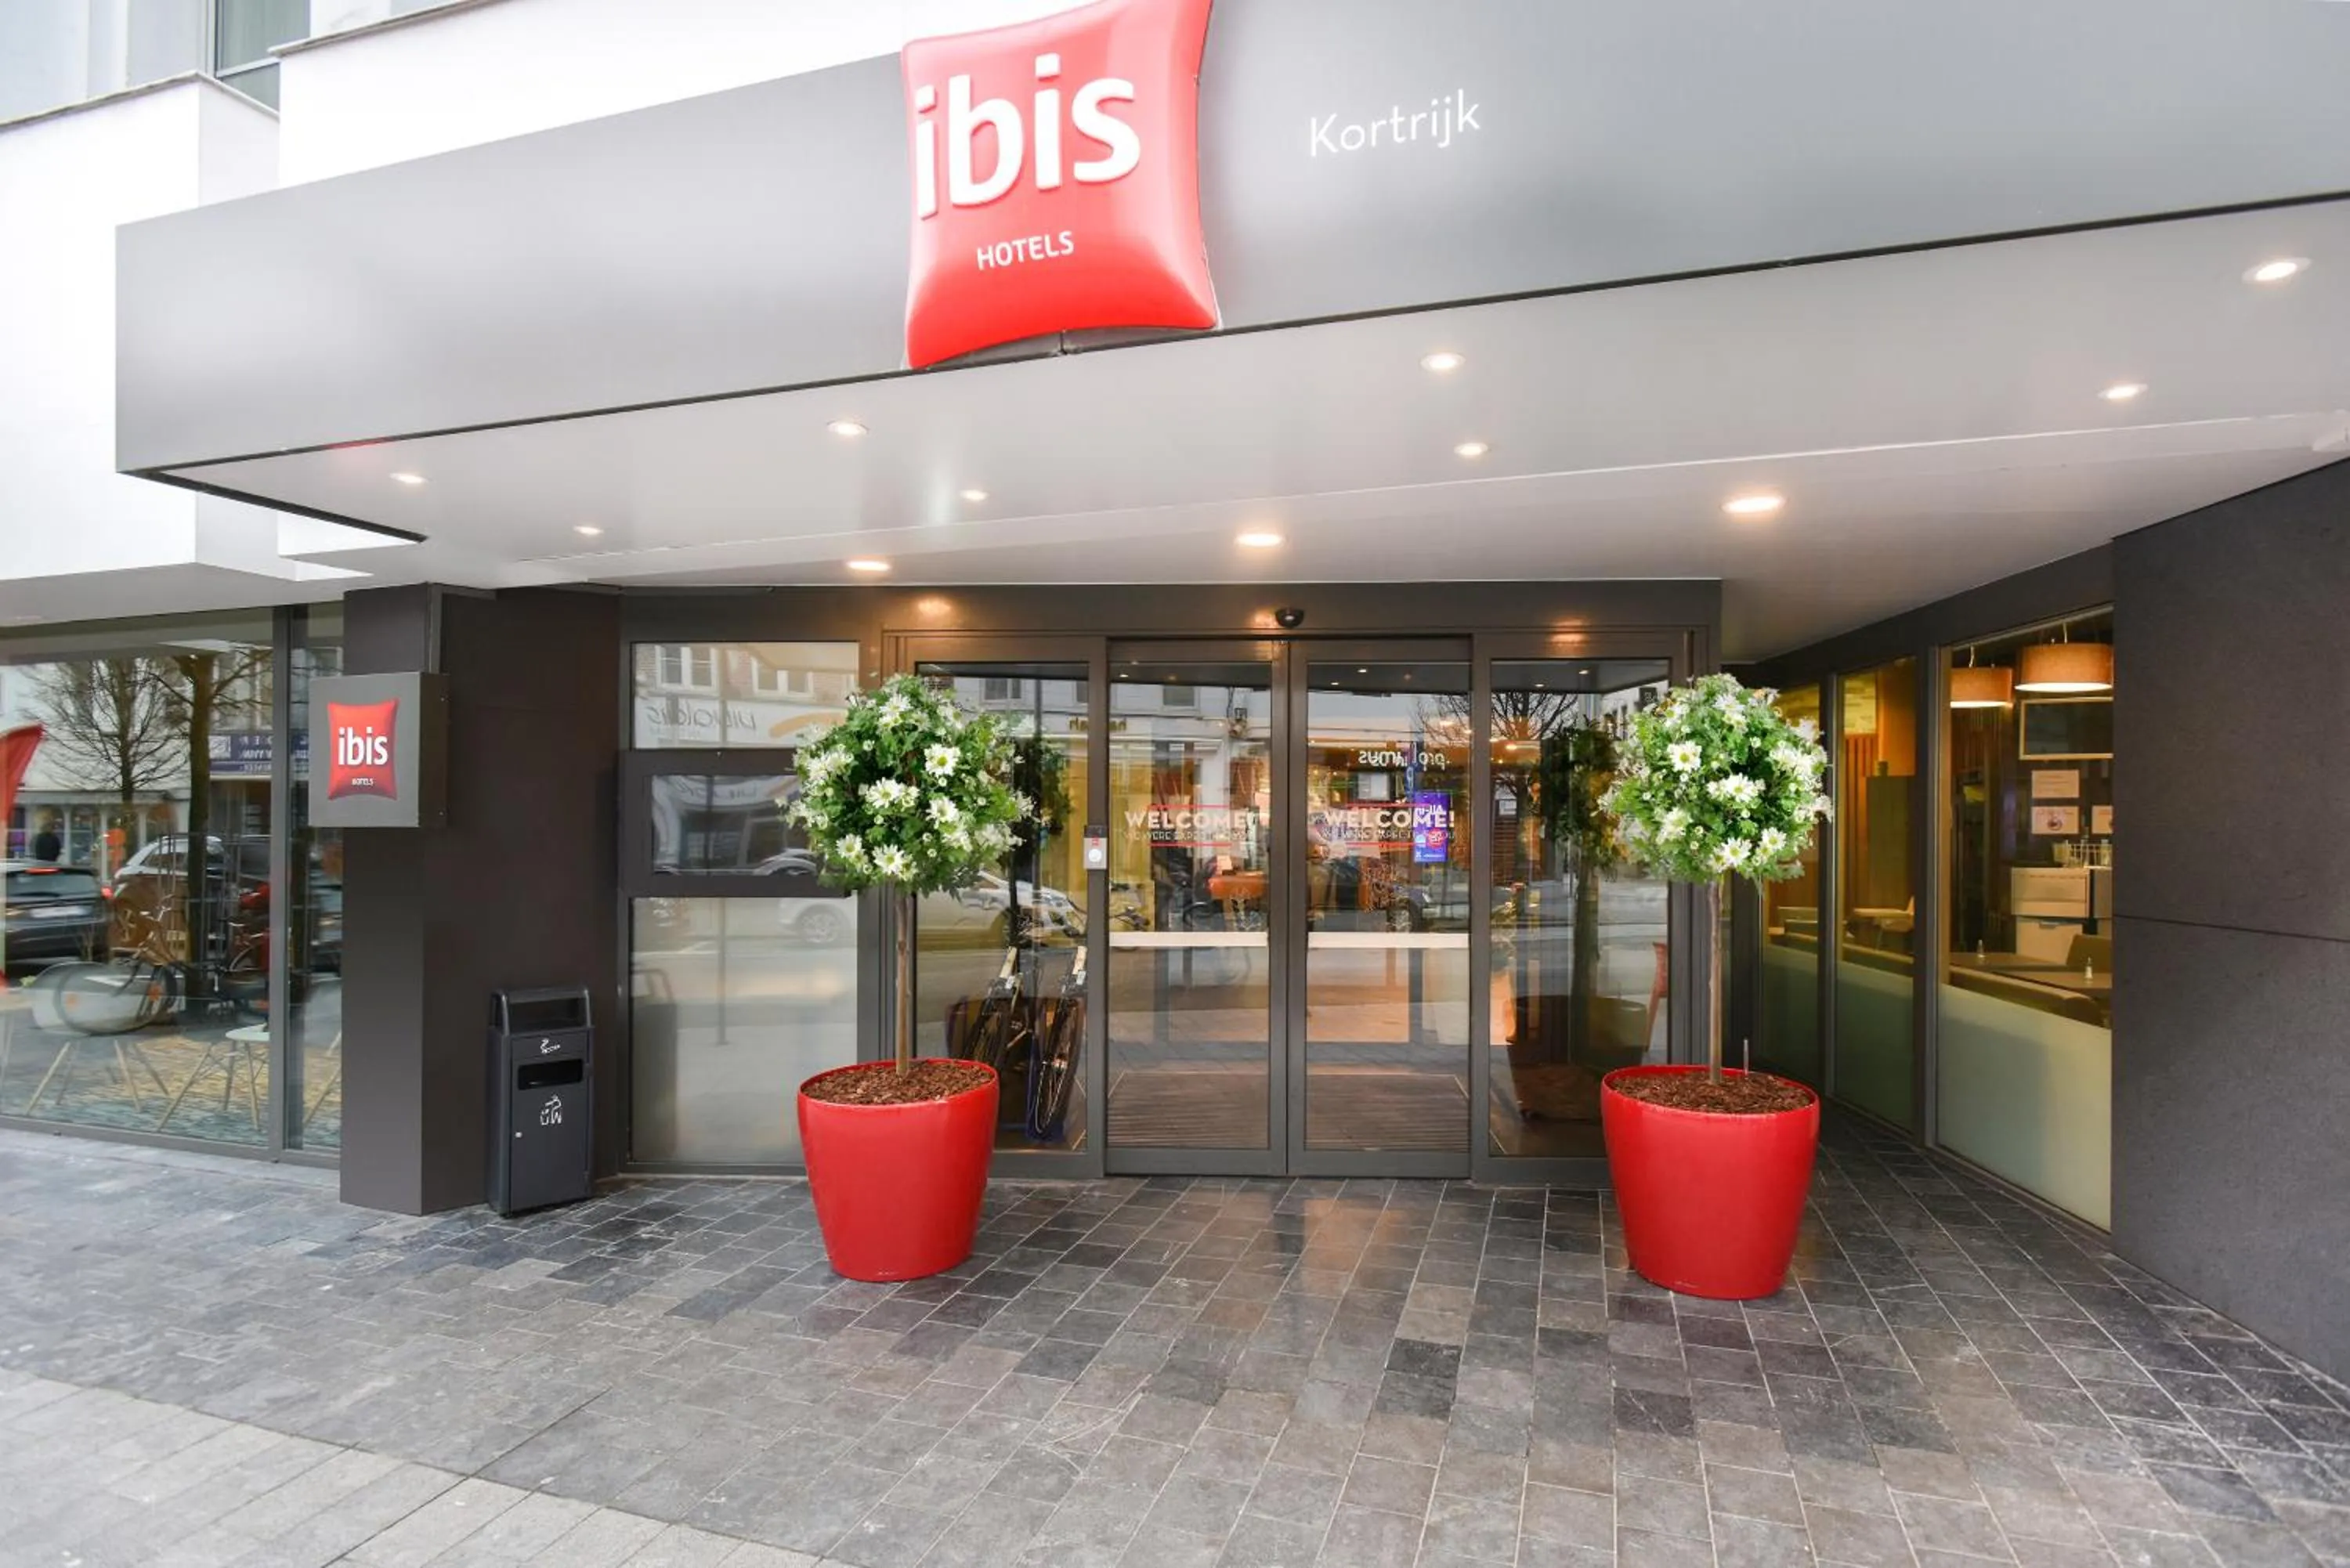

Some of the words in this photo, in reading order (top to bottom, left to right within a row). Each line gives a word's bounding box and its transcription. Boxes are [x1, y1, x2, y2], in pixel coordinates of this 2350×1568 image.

[915, 52, 1141, 220] ibis
[1311, 88, 1480, 157] Kortrijk
[977, 231, 1075, 270] HOTELS
[338, 726, 389, 765] ibis
[1324, 811, 1455, 828] WELCOME!
